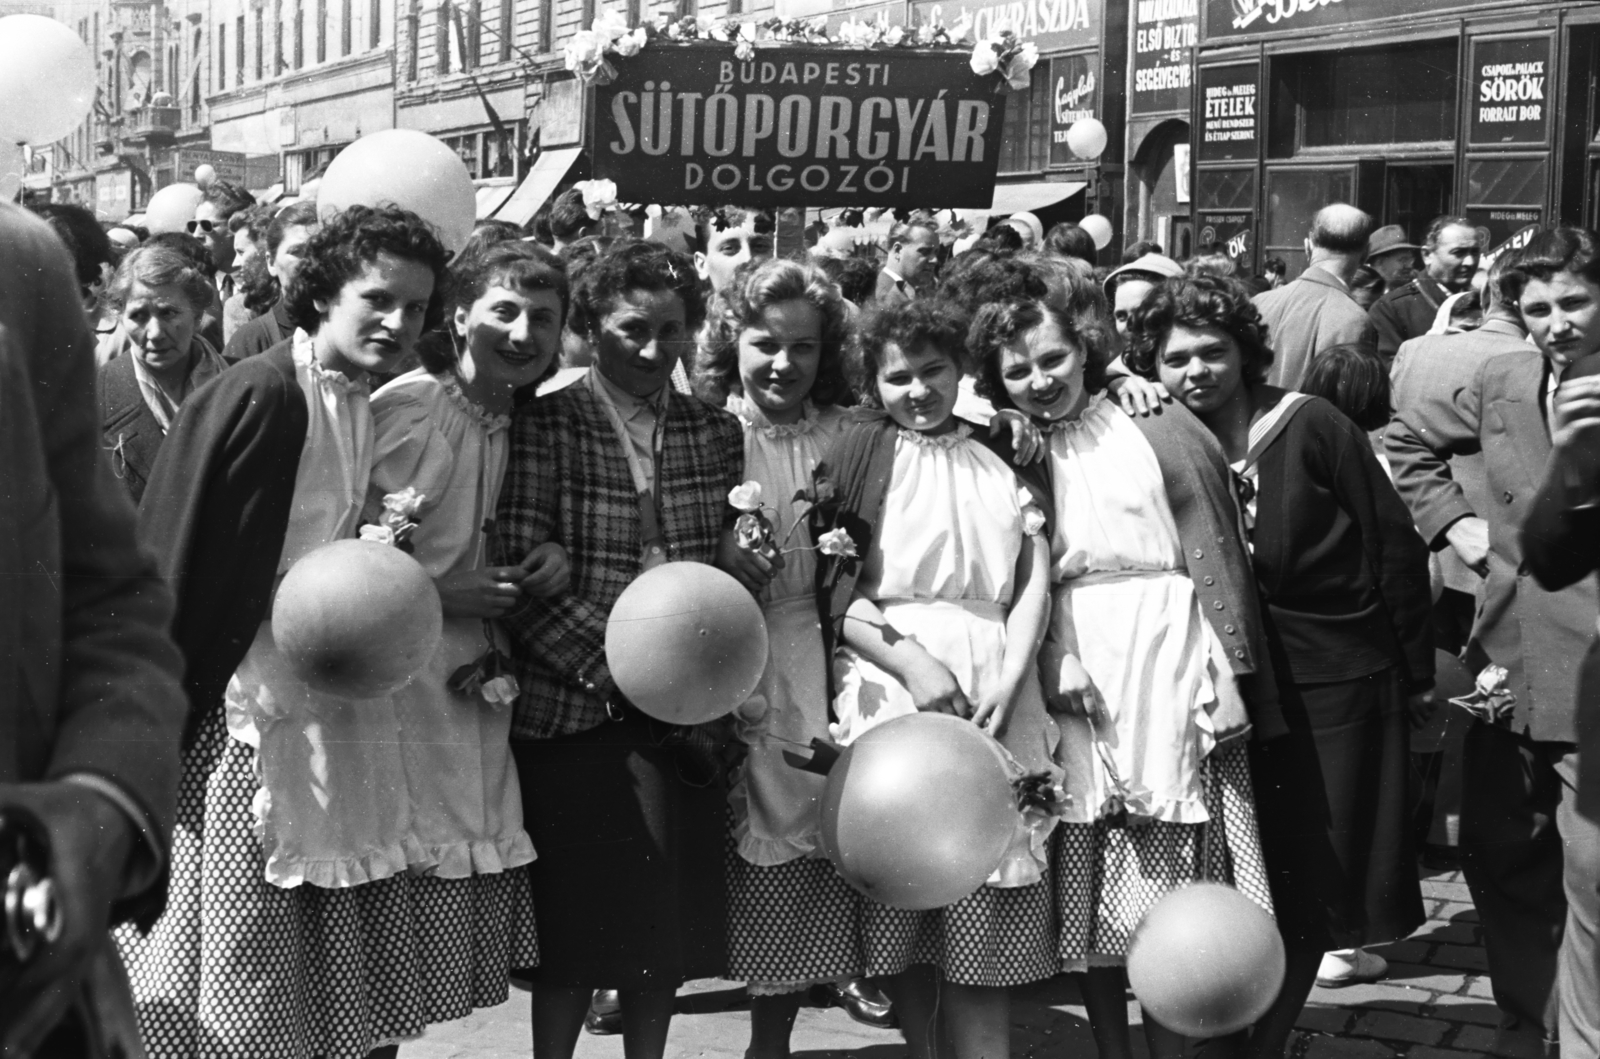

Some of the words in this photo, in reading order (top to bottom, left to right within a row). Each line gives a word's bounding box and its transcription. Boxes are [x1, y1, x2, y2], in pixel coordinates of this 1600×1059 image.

[1164, 23, 1198, 50] BIZTO
[719, 61, 889, 86] BUDAPESTI
[1135, 60, 1191, 91] SEGÉLYEGYE
[1516, 61, 1544, 75] PALACK
[1206, 86, 1227, 98] HIDEG
[1232, 84, 1256, 95] MELEG
[1480, 75, 1545, 102] SÖRÖK
[1205, 96, 1255, 118] ÉTELEK
[1519, 104, 1541, 121] BOR
[610, 80, 990, 162] SÜTŐPORGYÁR
[685, 160, 910, 193] DOLGOZÓI
[1227, 233, 1247, 258] ÖK
